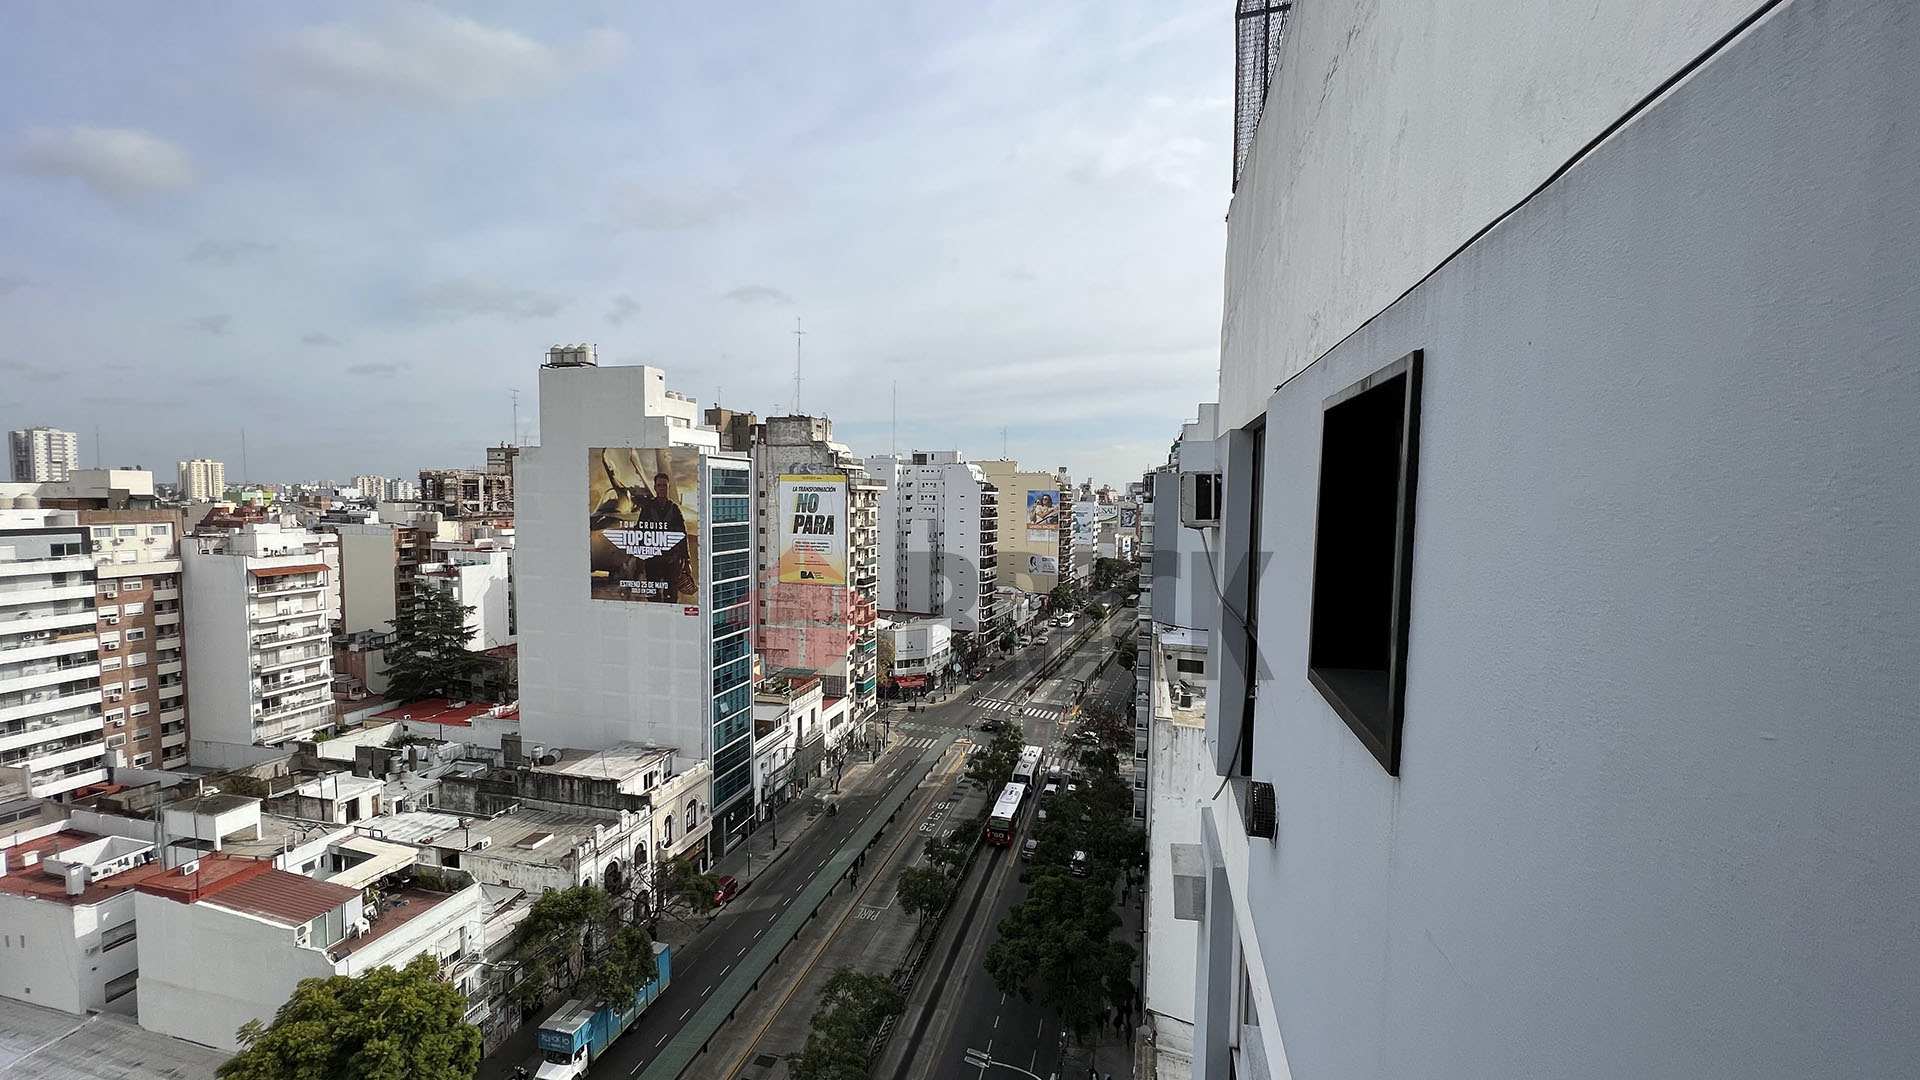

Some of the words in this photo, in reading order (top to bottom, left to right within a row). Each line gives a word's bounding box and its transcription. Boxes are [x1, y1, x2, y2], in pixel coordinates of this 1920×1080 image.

[795, 493, 819, 513] NO
[619, 520, 635, 529] TOM
[639, 521, 668, 530] CRUISE
[793, 514, 834, 535] PARA
[622, 530, 643, 546] TOP
[643, 531, 669, 547] GUN
[626, 546, 662, 556] MAVERICK
[800, 570, 815, 579] BA
[655, 581, 669, 589] MAYO
